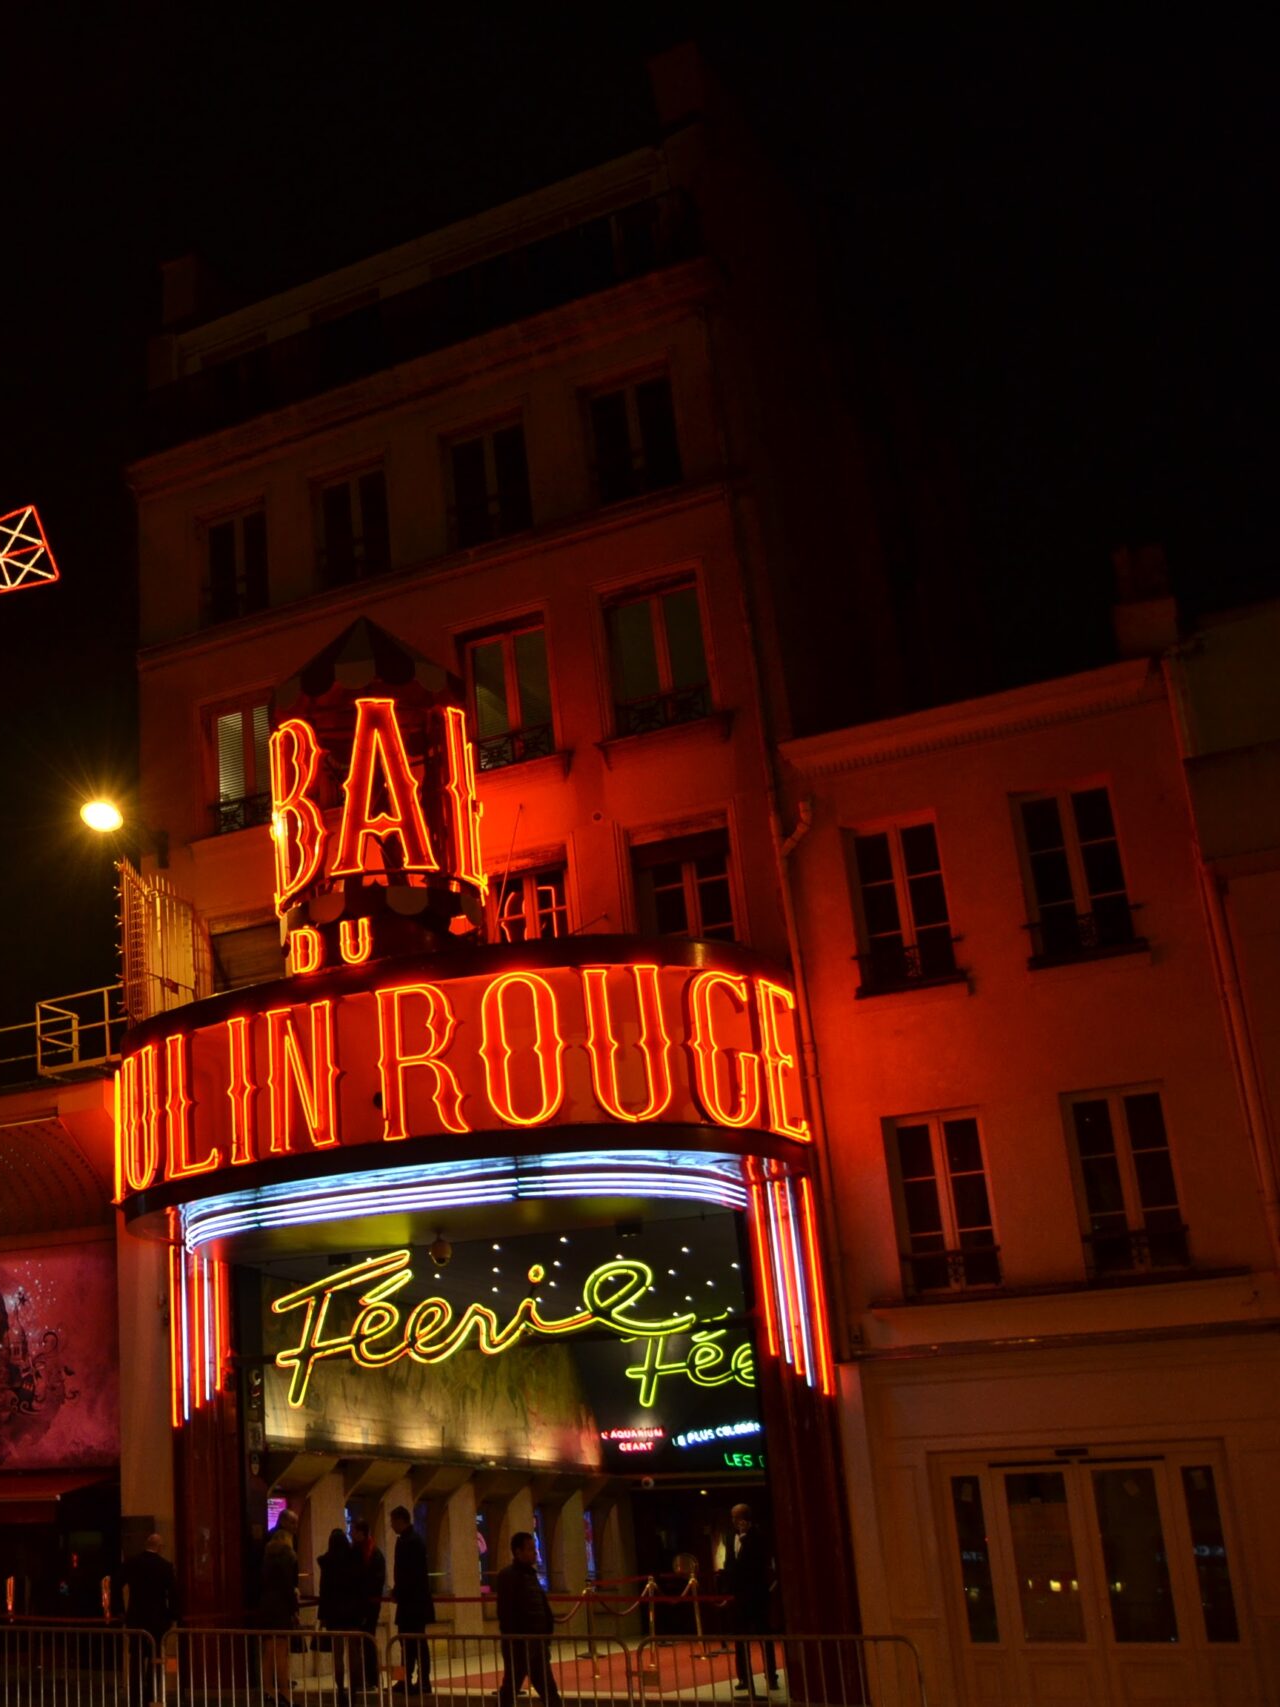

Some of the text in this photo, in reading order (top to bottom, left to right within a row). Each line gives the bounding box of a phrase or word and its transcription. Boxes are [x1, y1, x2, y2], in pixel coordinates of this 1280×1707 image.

[291, 917, 372, 974] DU
[114, 964, 812, 1203] ULIN ROUGE
[687, 1428, 715, 1444] PLUS
[724, 1453, 753, 1467] LES
